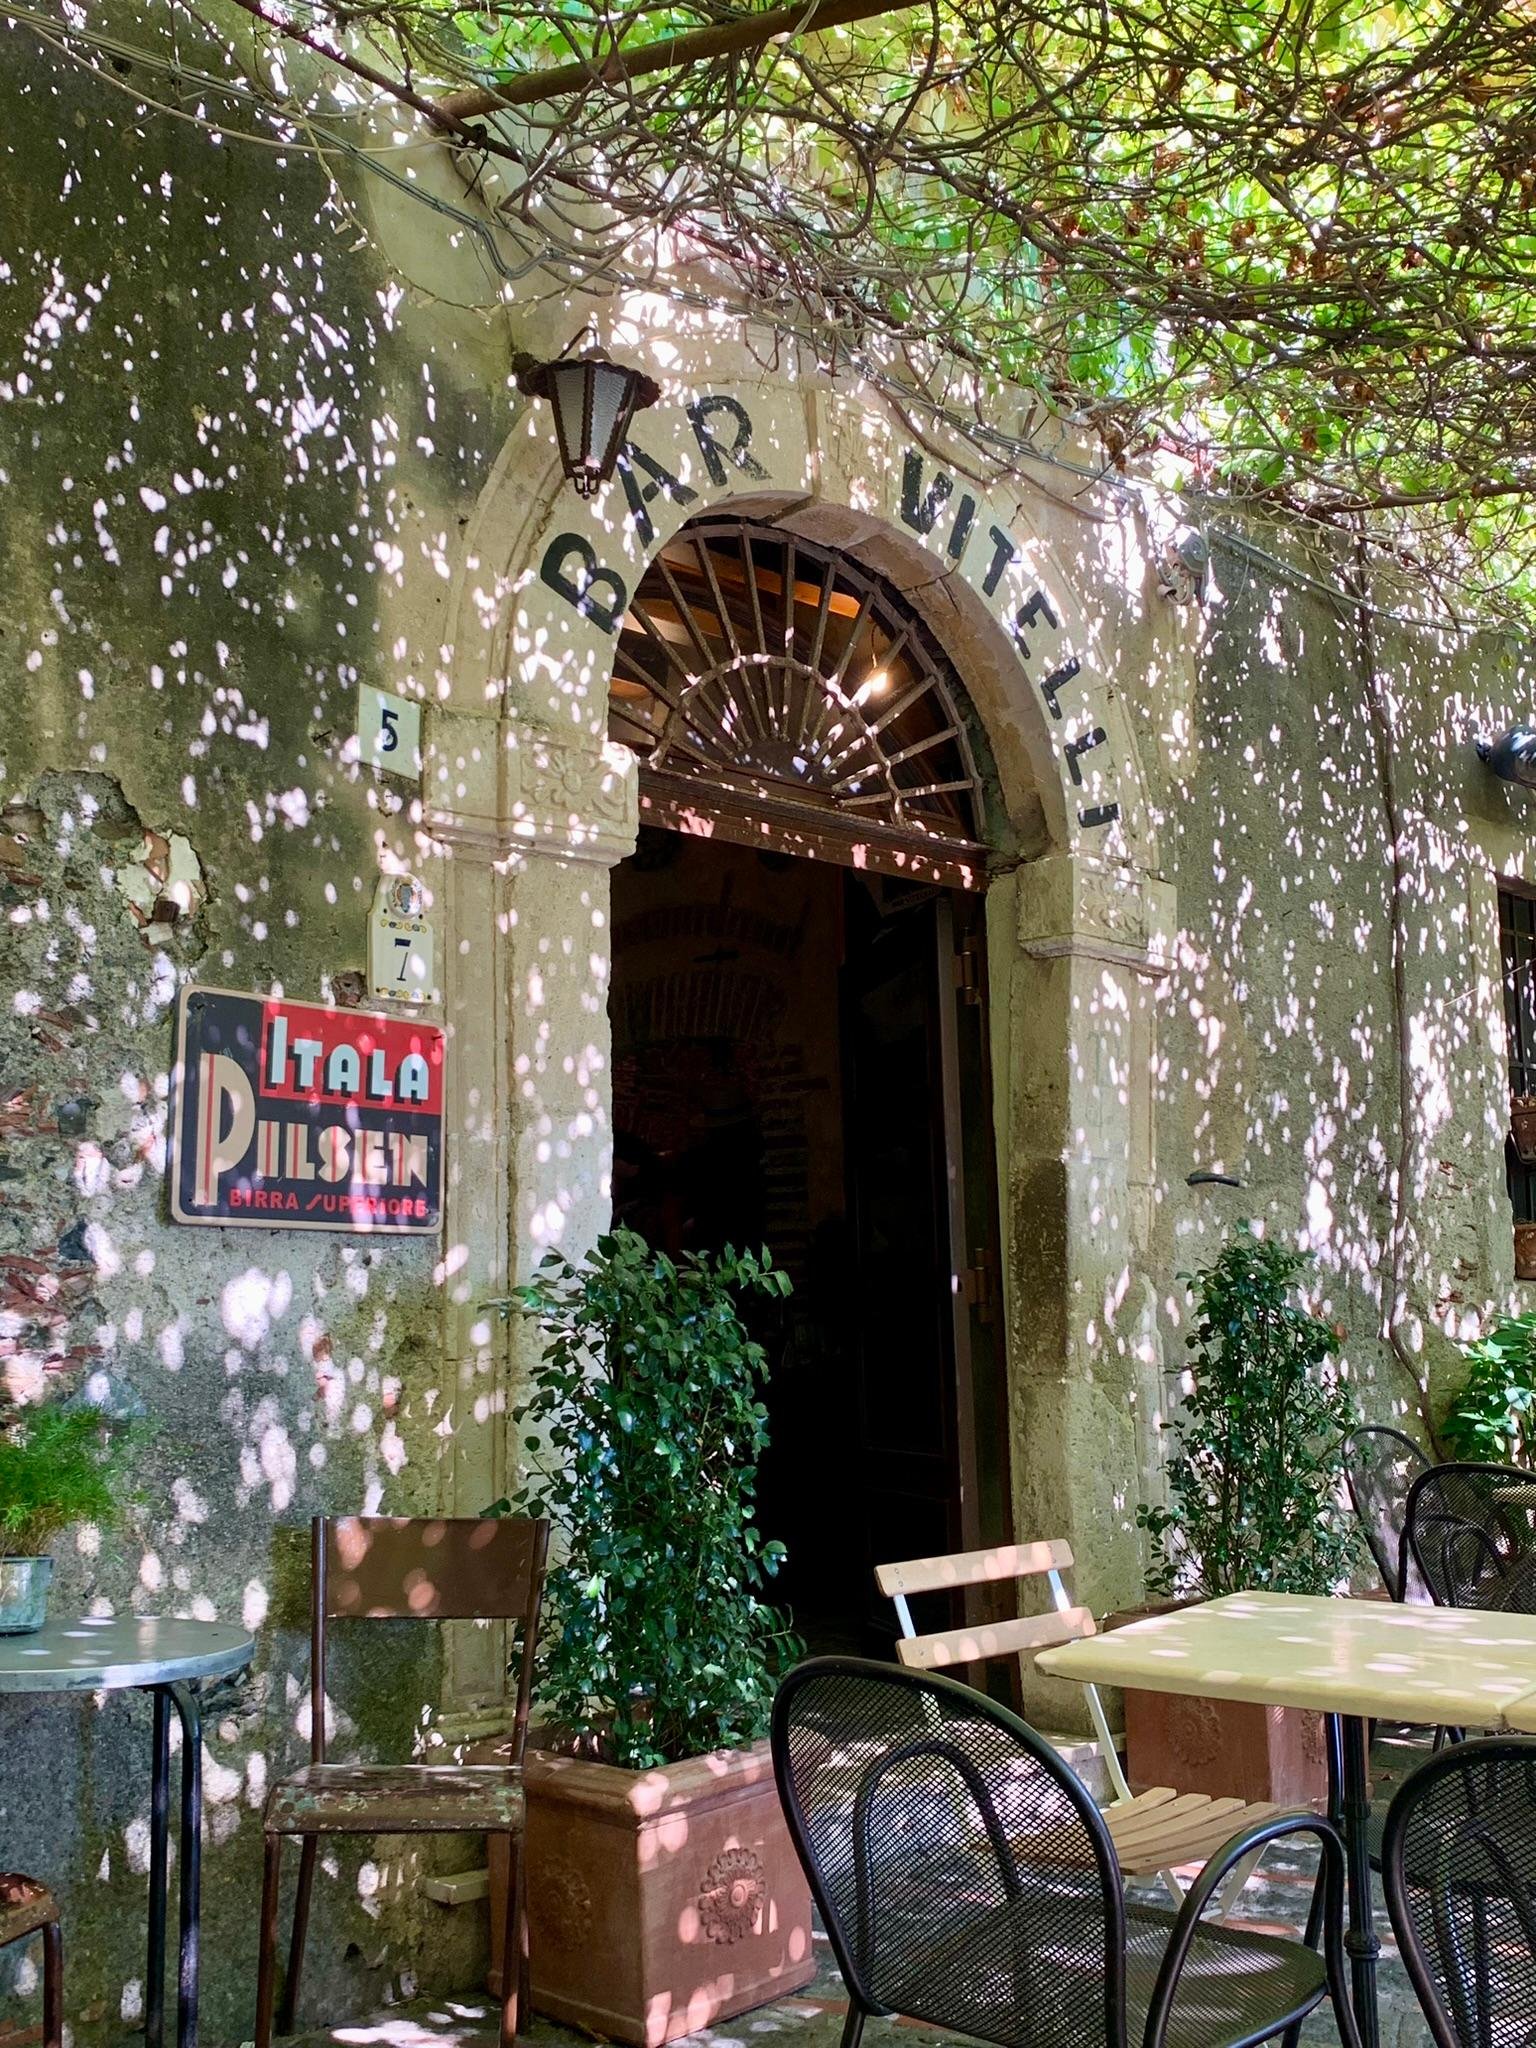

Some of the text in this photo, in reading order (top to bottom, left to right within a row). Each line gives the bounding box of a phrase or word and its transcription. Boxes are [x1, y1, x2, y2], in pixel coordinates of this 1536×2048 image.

[541, 395, 1120, 828] BAR VITELLI
[382, 708, 398, 751] 5
[394, 937, 411, 982] 7
[268, 1016, 430, 1103] ITALA
[194, 1053, 428, 1206] PILSEN
[229, 1189, 299, 1210] BIRRA
